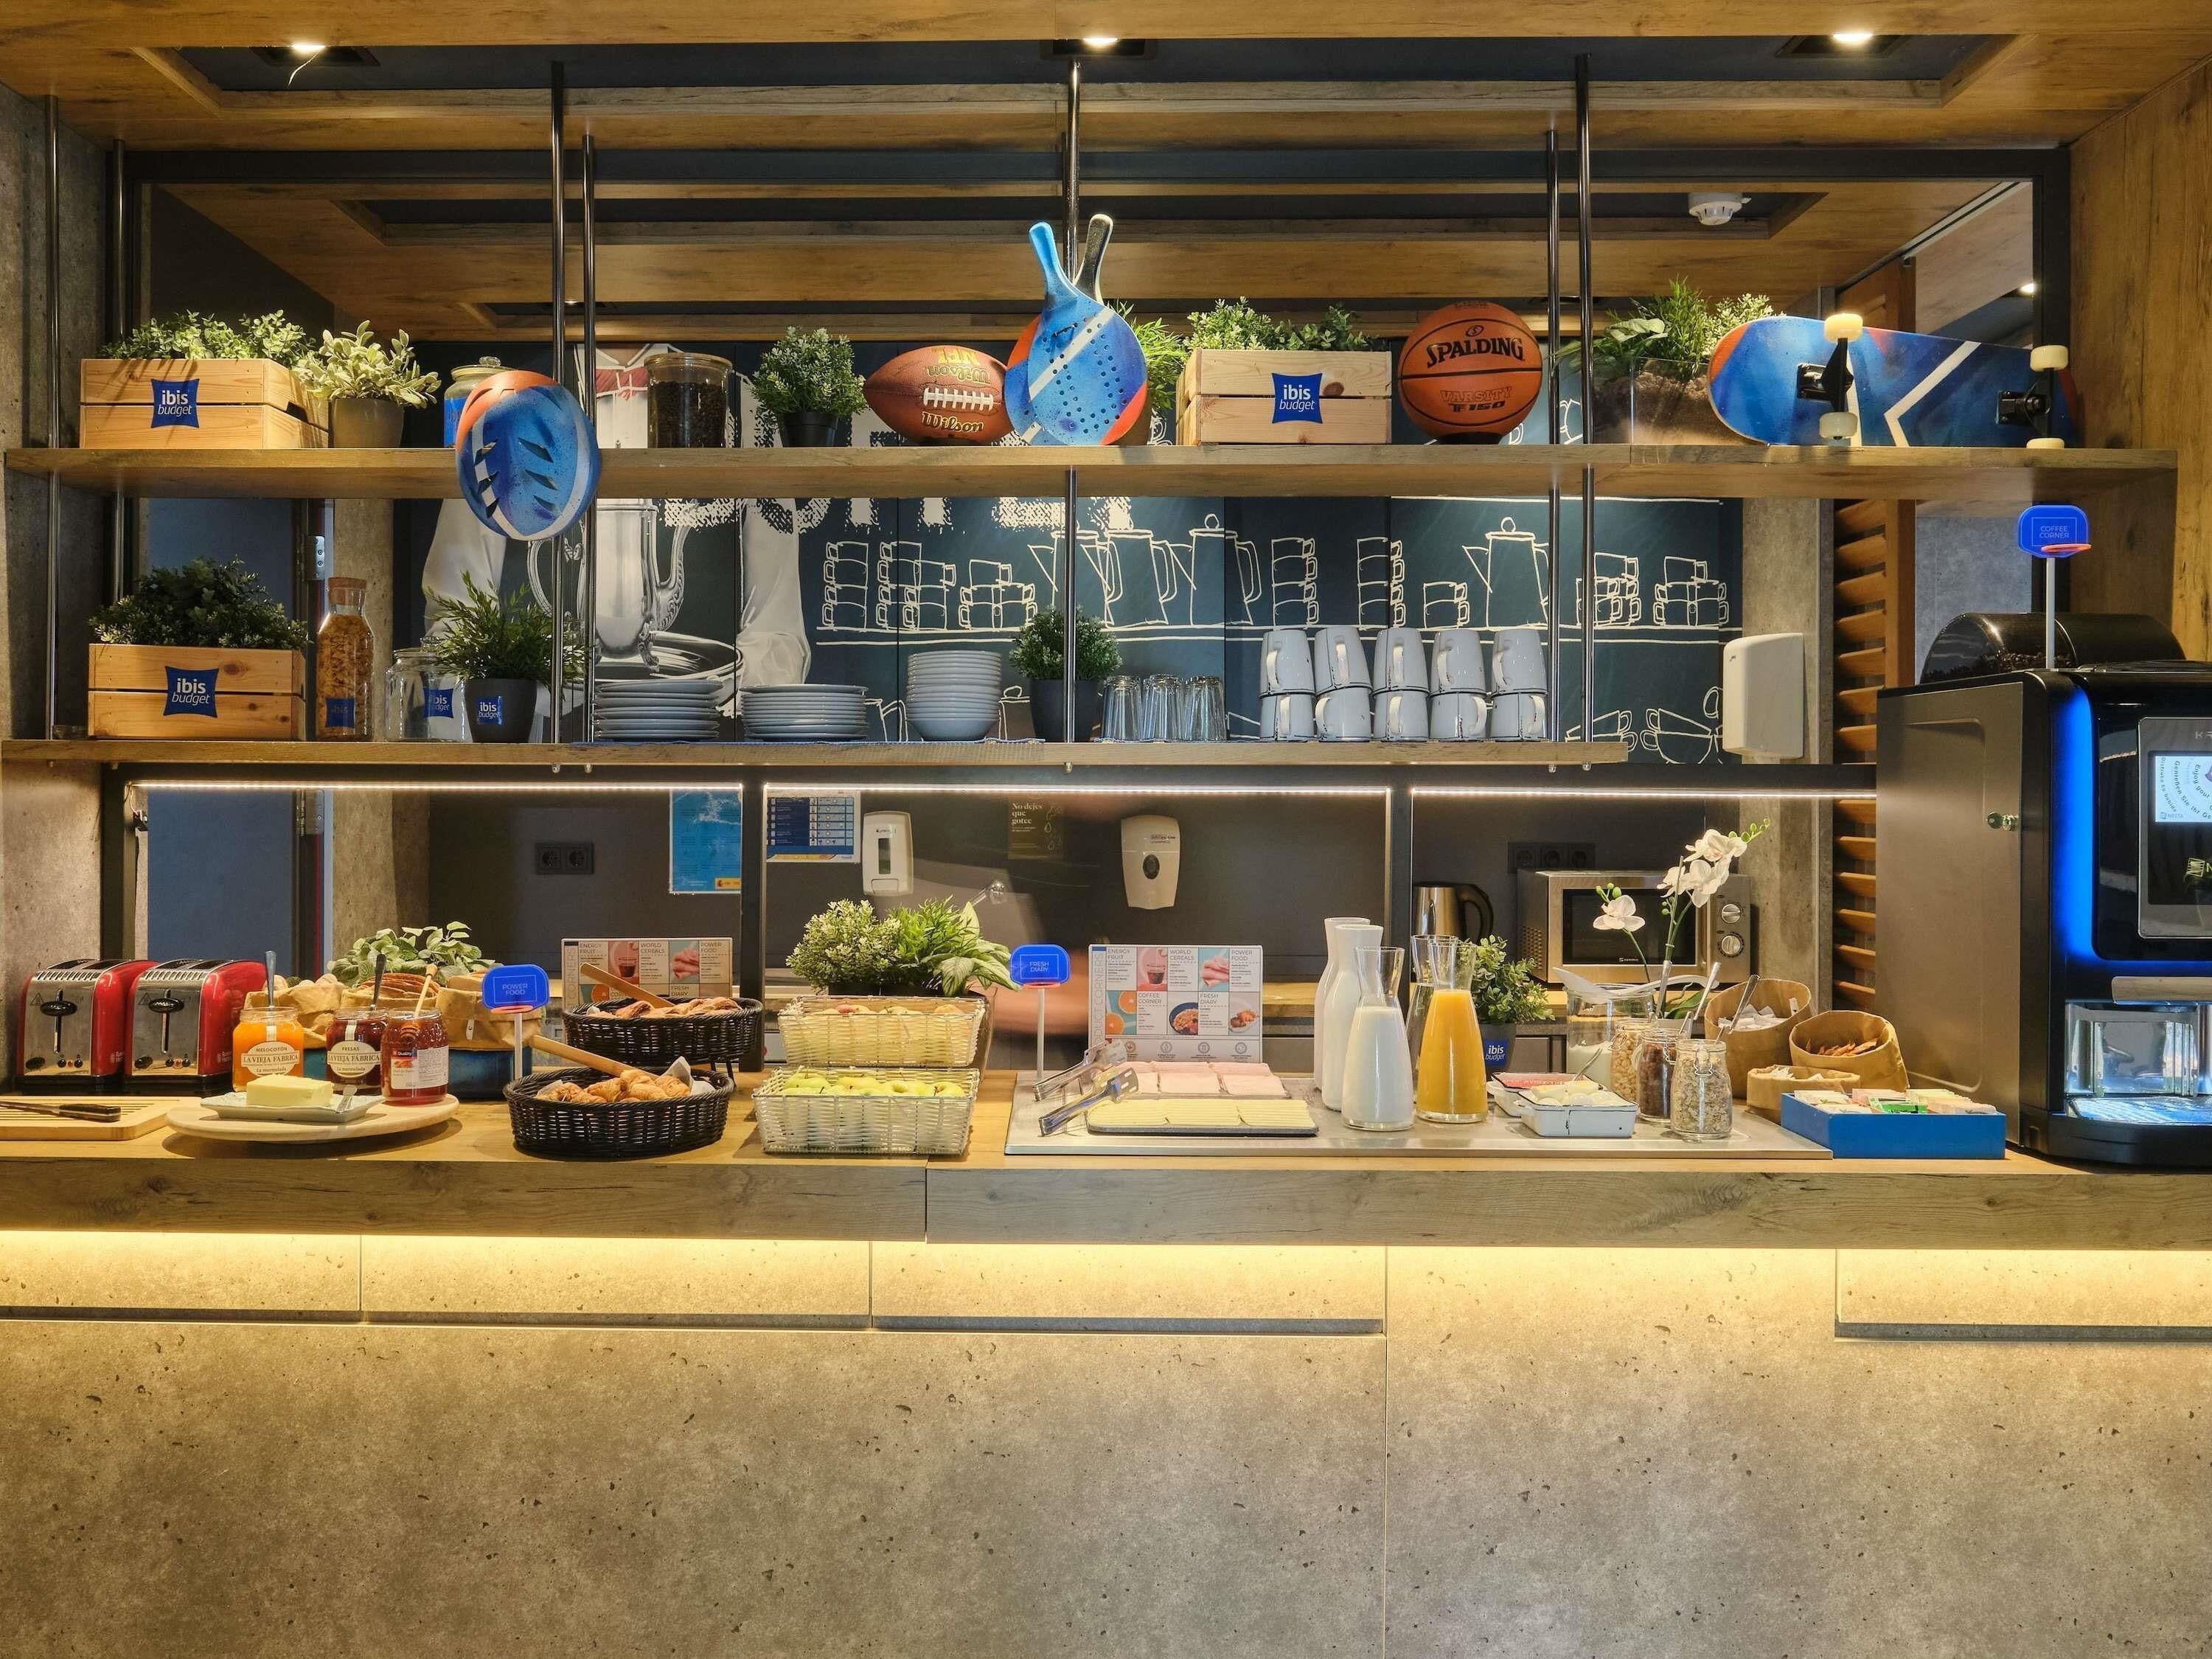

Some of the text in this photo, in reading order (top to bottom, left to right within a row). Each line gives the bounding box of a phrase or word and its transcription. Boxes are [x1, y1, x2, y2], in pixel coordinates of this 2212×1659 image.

[1426, 338, 1524, 368] SPALDING
[927, 364, 991, 384] Wilson
[161, 389, 189, 405] ibis
[1283, 384, 1311, 400] ibis
[1440, 386, 1513, 403] VARSITY
[157, 404, 192, 417] budget
[1279, 399, 1315, 412] budget
[922, 411, 984, 432] Wilson
[177, 678, 206, 694] ibis
[171, 692, 210, 706] budget
[480, 701, 497, 712] ibis
[2192, 764, 2210, 799] Enjoy your
[1024, 802, 1043, 811] dejes
[2181, 796, 2190, 807] Sie
[2191, 805, 2200, 814] Ihr
[1488, 1045, 1504, 1054] ibis
